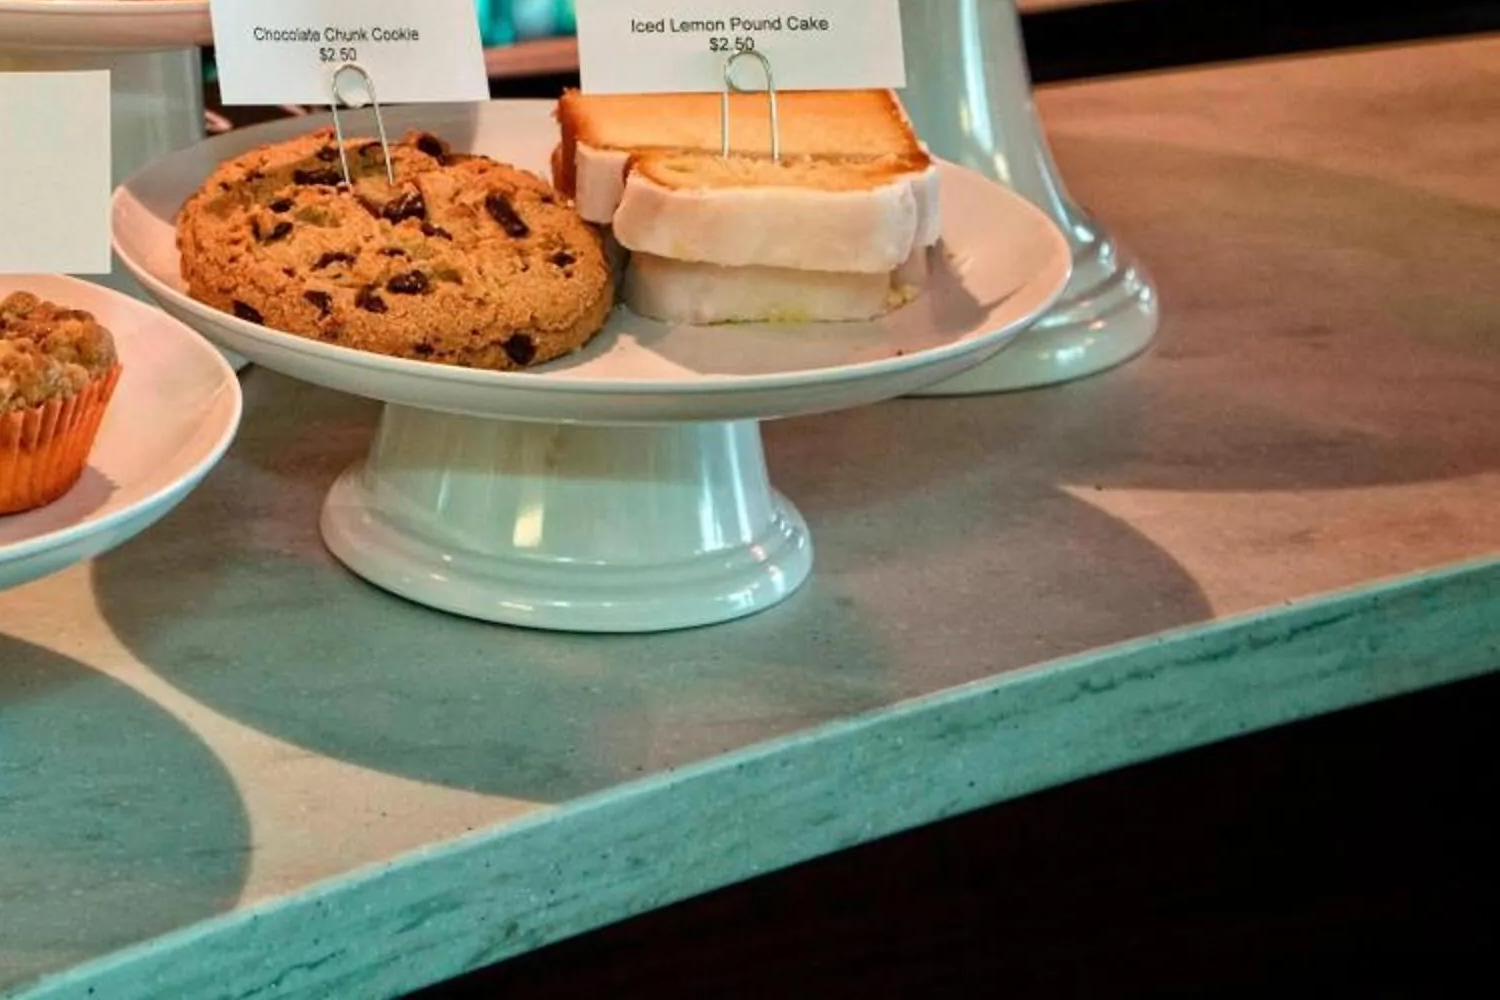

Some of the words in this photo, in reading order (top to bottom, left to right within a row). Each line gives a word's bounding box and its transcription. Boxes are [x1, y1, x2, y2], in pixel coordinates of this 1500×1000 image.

[631, 18, 664, 33] Iced
[670, 18, 725, 32] Lemon
[730, 17, 781, 32] Pound
[787, 16, 830, 30] Cake
[253, 27, 321, 42] Chocolate
[325, 27, 368, 42] Chunk
[372, 27, 419, 41] Cookie
[709, 36, 754, 52] $2.50
